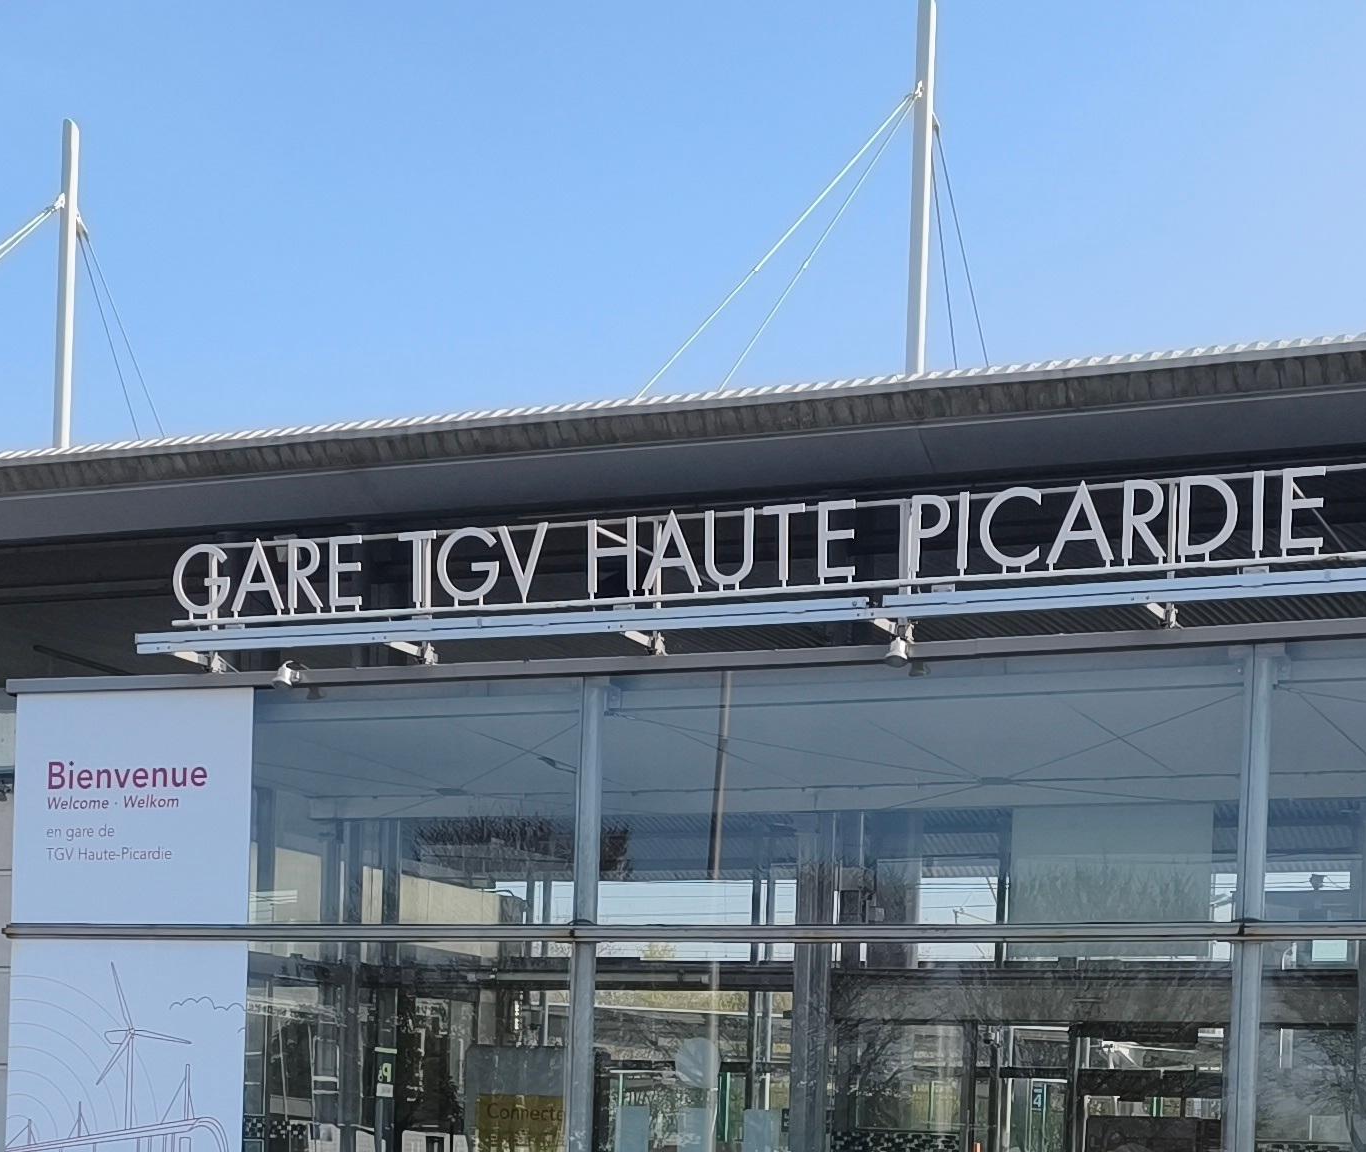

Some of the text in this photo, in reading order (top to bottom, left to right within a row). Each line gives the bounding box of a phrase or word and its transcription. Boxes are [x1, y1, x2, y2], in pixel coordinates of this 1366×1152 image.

[172, 465, 1327, 614] GARE TGV HAUTE PICARDIE
[47, 760, 208, 790] Bienvenue
[47, 793, 179, 811] Welcome Welkom
[46, 824, 116, 842] en gare de
[46, 845, 173, 861] TGV Haute-Picardie
